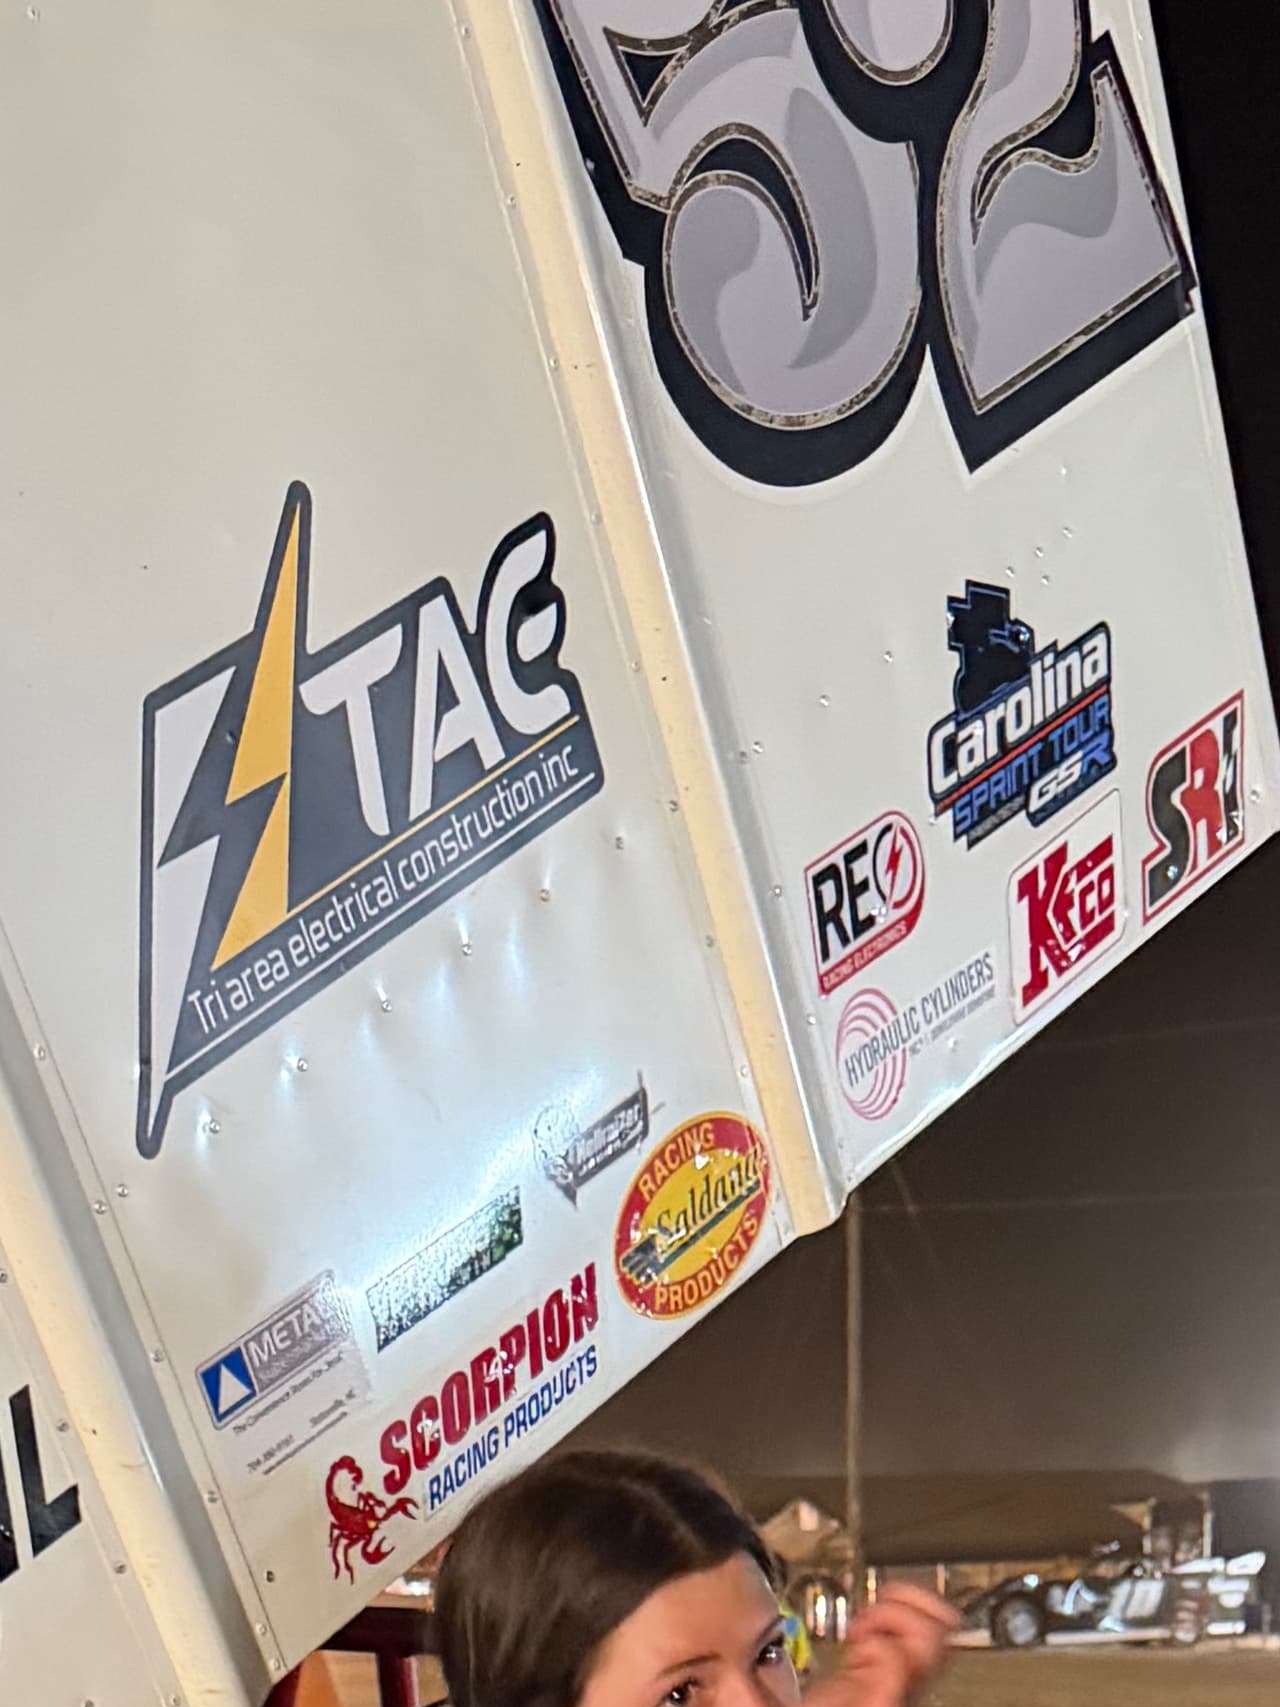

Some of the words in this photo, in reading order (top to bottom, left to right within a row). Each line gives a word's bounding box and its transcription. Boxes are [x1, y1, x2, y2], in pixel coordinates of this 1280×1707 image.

[930, 632, 1108, 795] Carolina
[954, 743, 1042, 834] SPRINT
[1048, 696, 1109, 761] TOUR
[189, 980, 228, 1033] Tri
[225, 949, 289, 1011] area
[290, 861, 397, 968] electrical
[398, 779, 544, 891] construction
[539, 745, 578, 793] inc
[845, 1006, 920, 1086] HYDRAULIC
[921, 953, 994, 1024] CYLINDERS
[638, 1122, 715, 1199] RACING
[655, 1209, 758, 1311] PRODUCTS
[380, 1262, 598, 1495] SCORPION
[429, 1427, 499, 1510] RACING
[504, 1344, 596, 1447] PRODUCTS
